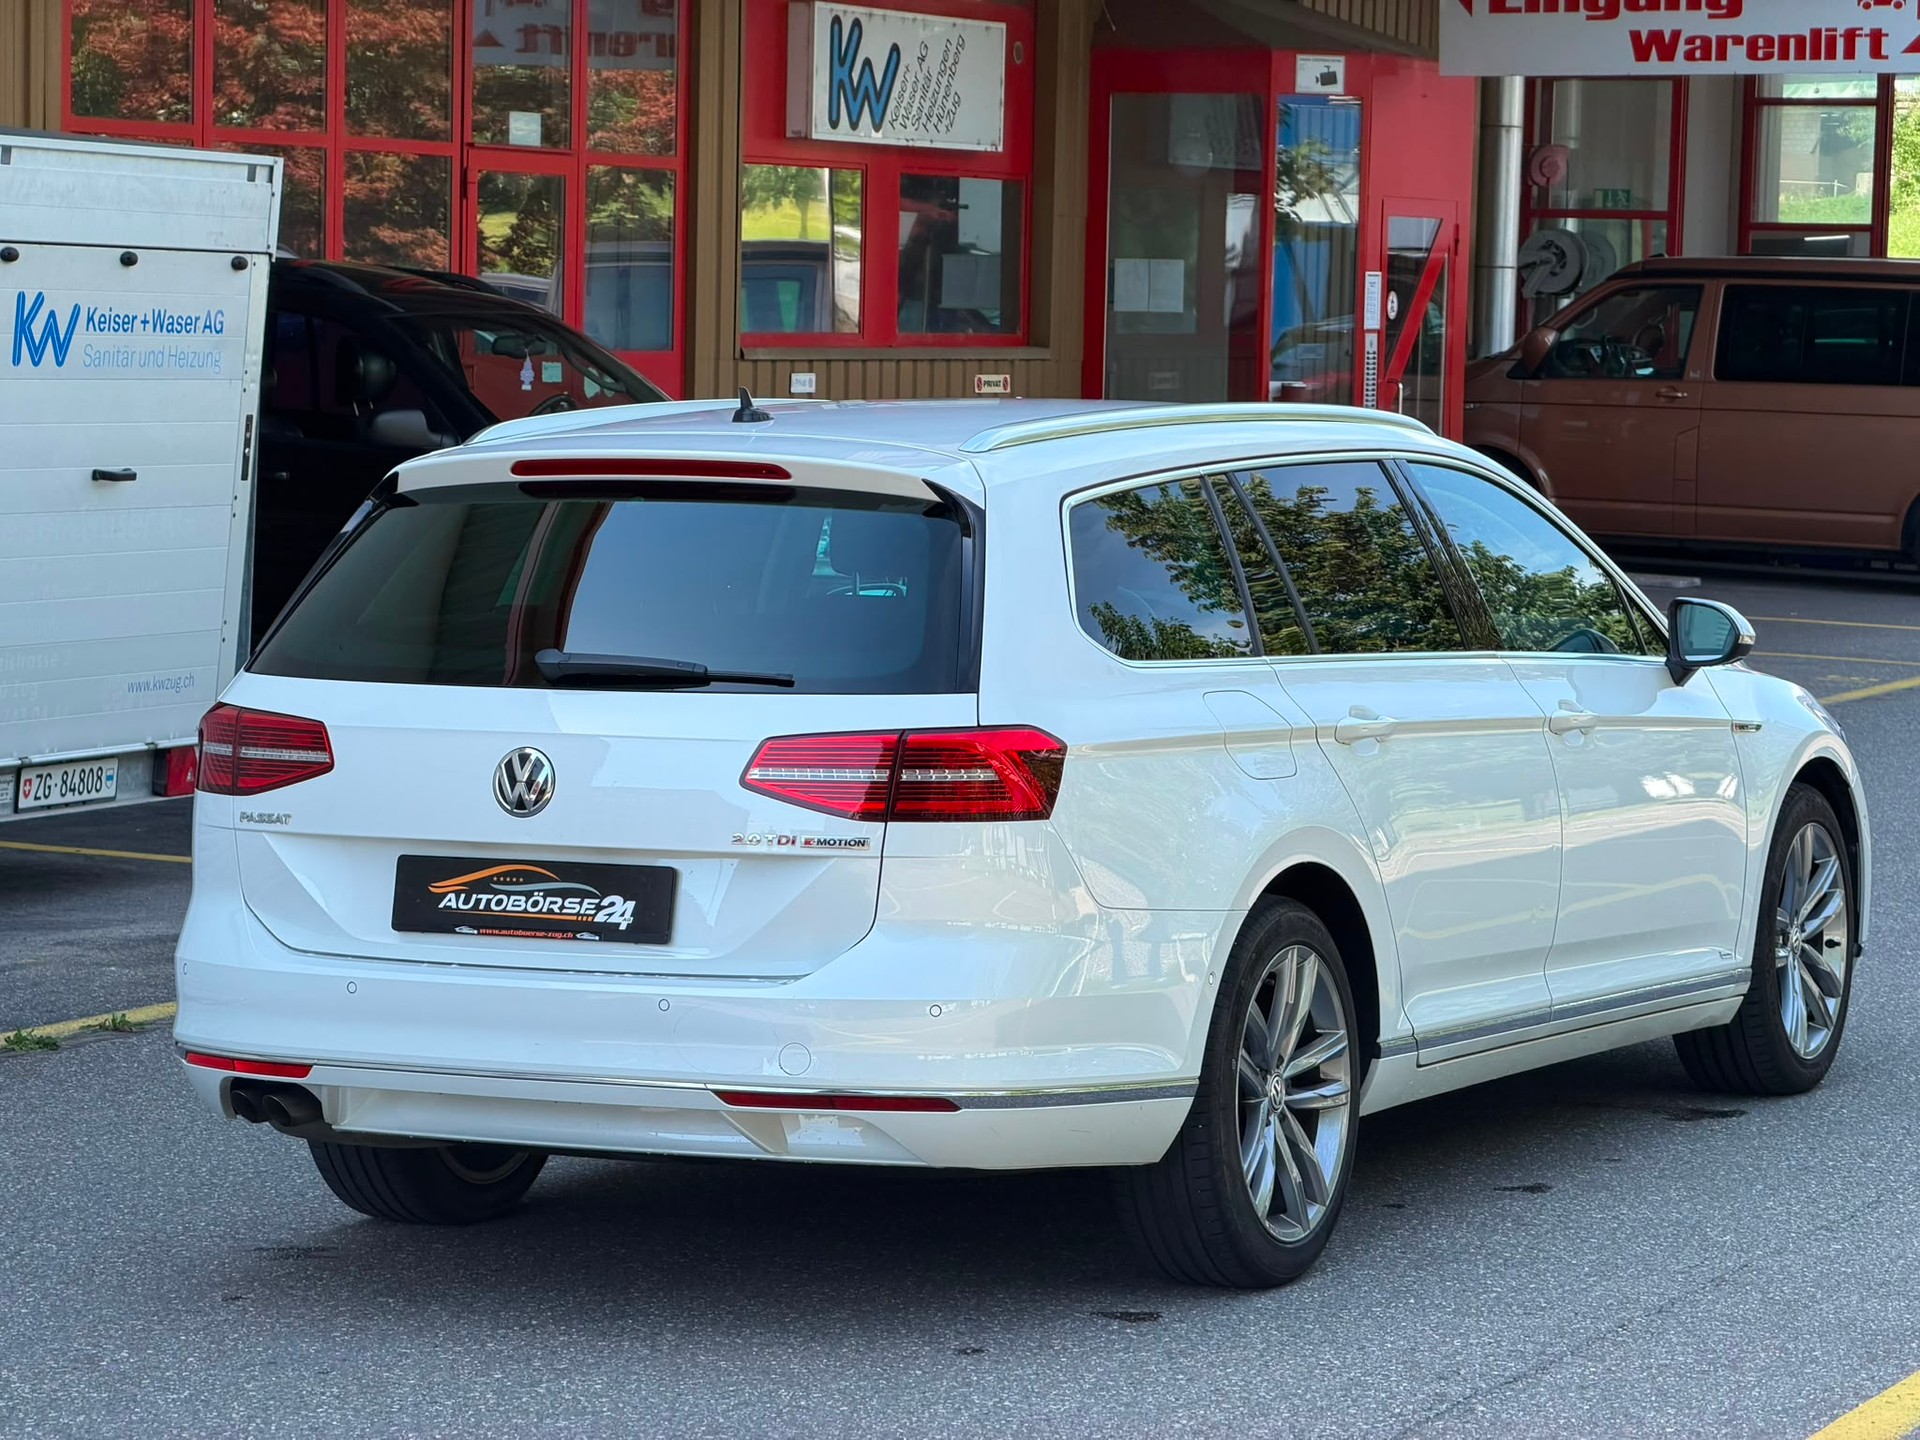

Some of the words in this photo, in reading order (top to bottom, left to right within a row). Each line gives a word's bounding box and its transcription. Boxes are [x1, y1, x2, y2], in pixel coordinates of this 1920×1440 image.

[1629, 27, 1889, 62] Warenlift
[828, 14, 901, 133] KW
[900, 71, 922, 130] Waser
[917, 41, 929, 72] AG
[922, 38, 953, 133] Heizungen
[933, 34, 966, 134] Hünenberg
[911, 66, 933, 132] Sanitär
[12, 290, 81, 367] KW
[202, 309, 225, 334] AG
[83, 343, 136, 368] Sanitär
[138, 345, 164, 368] und
[168, 345, 222, 375] Heizung
[127, 673, 195, 693] www.kwzug.ch
[239, 811, 293, 826] PASSAT
[479, 927, 574, 940] www.autoboerse-zug.ch
